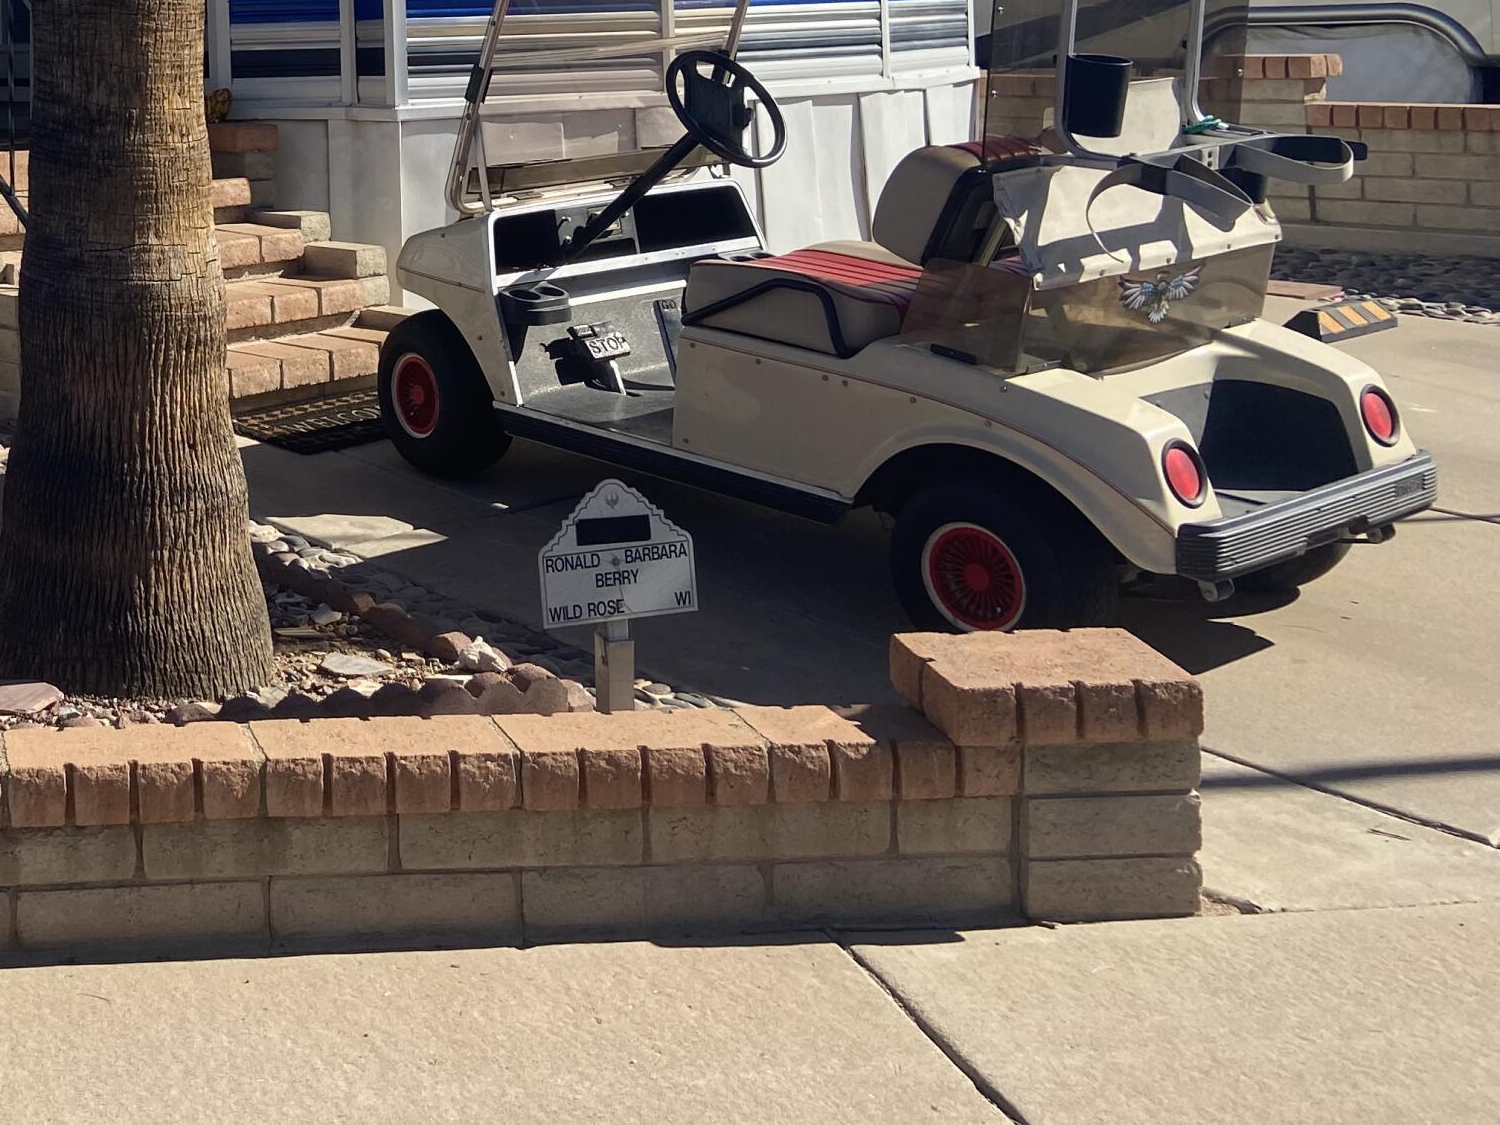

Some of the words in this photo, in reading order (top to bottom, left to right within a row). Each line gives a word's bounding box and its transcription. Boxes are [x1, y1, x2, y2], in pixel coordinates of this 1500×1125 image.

[661, 300, 676, 309] GO
[589, 335, 626, 353] STOP
[545, 553, 601, 573] RONALD
[624, 543, 688, 564] BARBARA
[595, 569, 639, 588] BERRY
[549, 604, 582, 622] WILD
[587, 599, 625, 617] ROSE
[674, 591, 692, 607] WI
